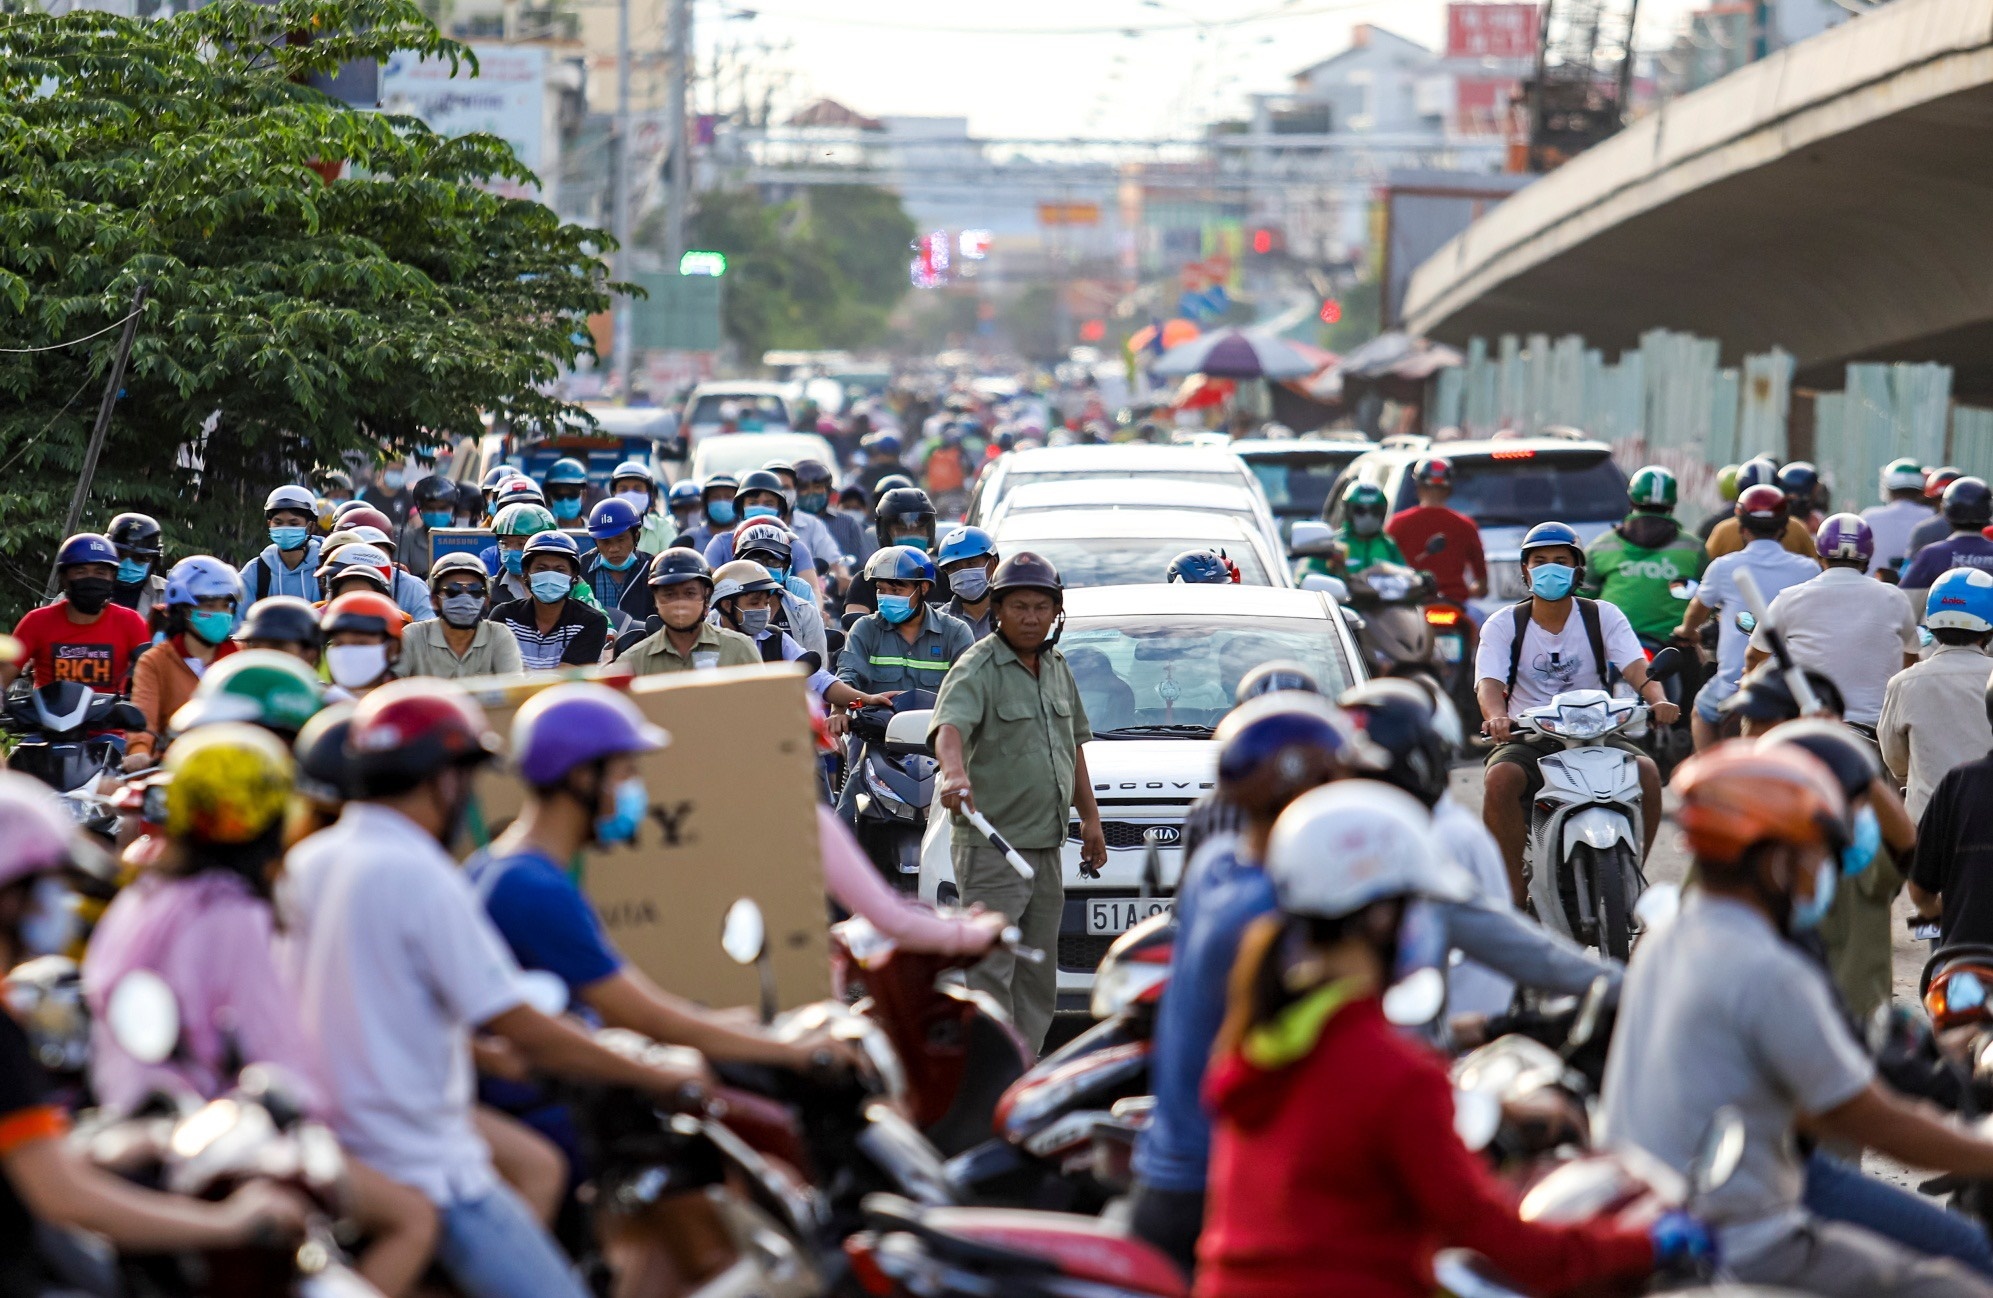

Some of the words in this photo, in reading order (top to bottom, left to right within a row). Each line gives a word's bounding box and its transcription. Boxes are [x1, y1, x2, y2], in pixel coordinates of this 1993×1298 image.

[601, 514, 613, 524] ila
[90, 541, 103, 551] ila
[437, 537, 479, 545] SAMSUNG
[55, 658, 111, 682] RICH
